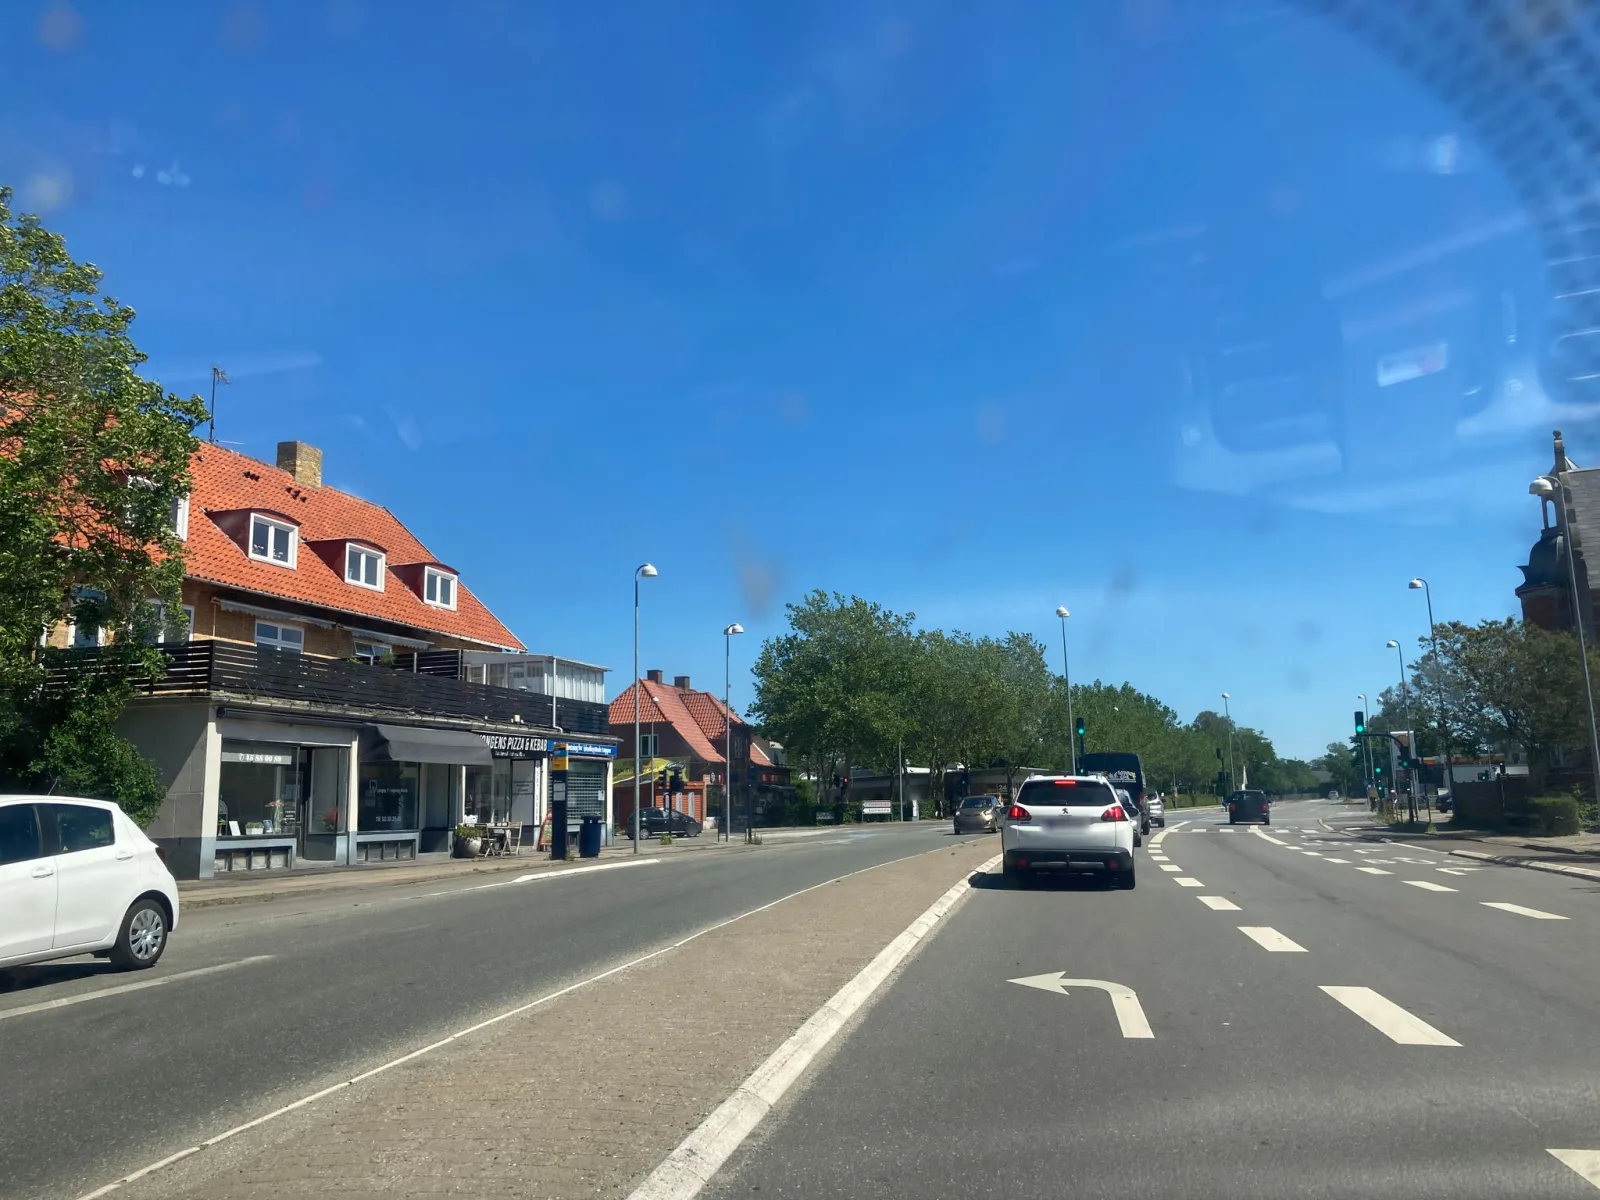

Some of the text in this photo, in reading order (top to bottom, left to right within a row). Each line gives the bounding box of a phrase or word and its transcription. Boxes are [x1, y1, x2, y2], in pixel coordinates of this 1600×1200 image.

[506, 737, 524, 750] PIZZA
[524, 738, 530, 750] &
[530, 738, 548, 751] KEBAB
